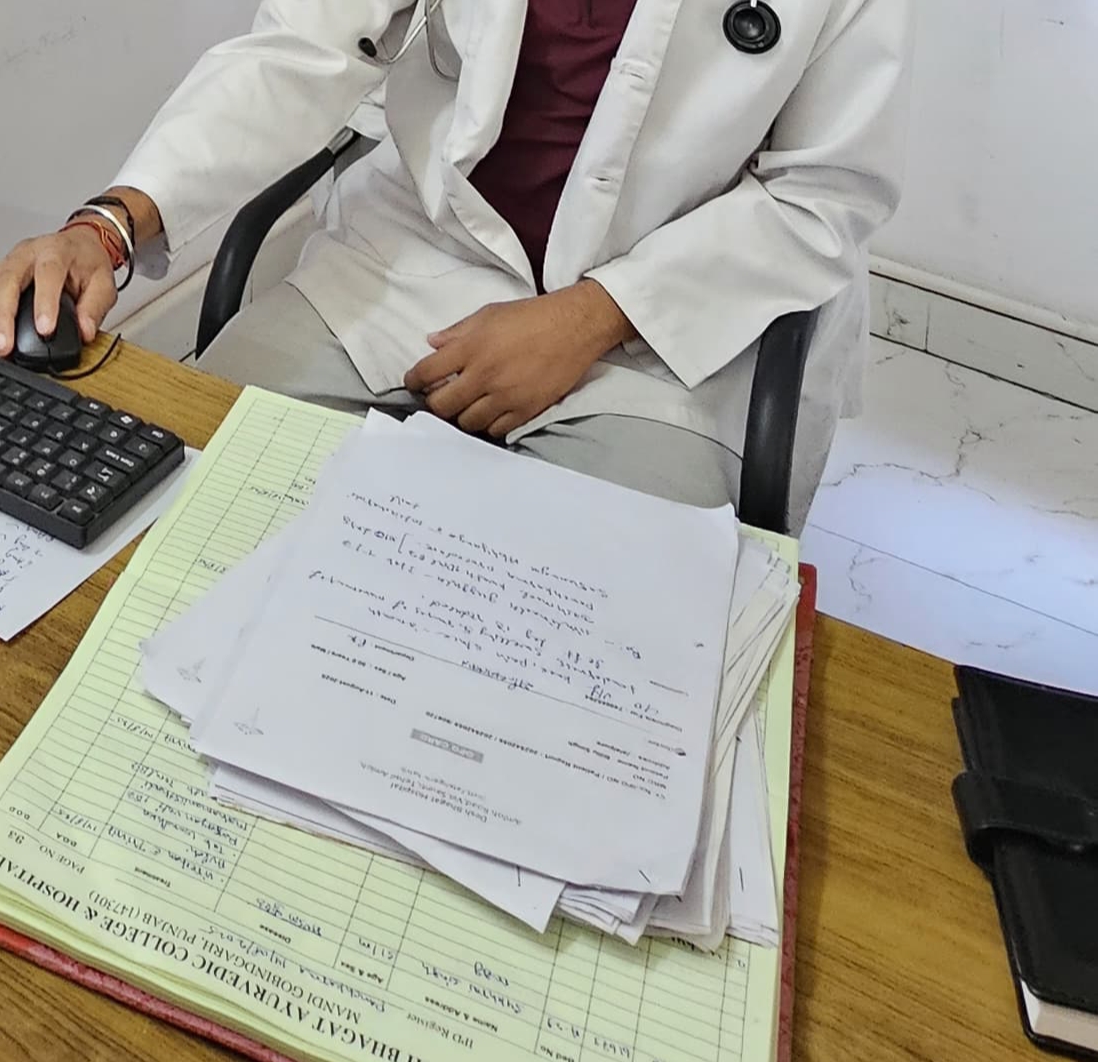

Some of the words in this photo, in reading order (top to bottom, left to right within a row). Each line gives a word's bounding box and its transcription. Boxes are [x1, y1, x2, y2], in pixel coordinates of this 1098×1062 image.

[36, 842, 57, 859] NO
[55, 851, 86, 875] PAGE
[133, 866, 172, 888] Treatment
[80, 904, 99, 923] &
[86, 887, 142, 921] (147301)
[98, 913, 191, 964] COLLEGE
[139, 910, 197, 946] PUNJAB
[257, 922, 292, 944] Disease
[196, 935, 306, 999] GOBINDGARH,
[338, 959, 356, 972] Sex
[363, 969, 385, 985] Age
[189, 951, 310, 1024] AYURVEDIC
[305, 990, 362, 1025] MANDI
[421, 994, 462, 1017] Address
[404, 1009, 452, 1039] Register
[470, 1014, 499, 1033] Name
[310, 1014, 401, 1062] BHAGAT
[450, 1031, 475, 1049] IPD
[537, 1043, 554, 1057] No
